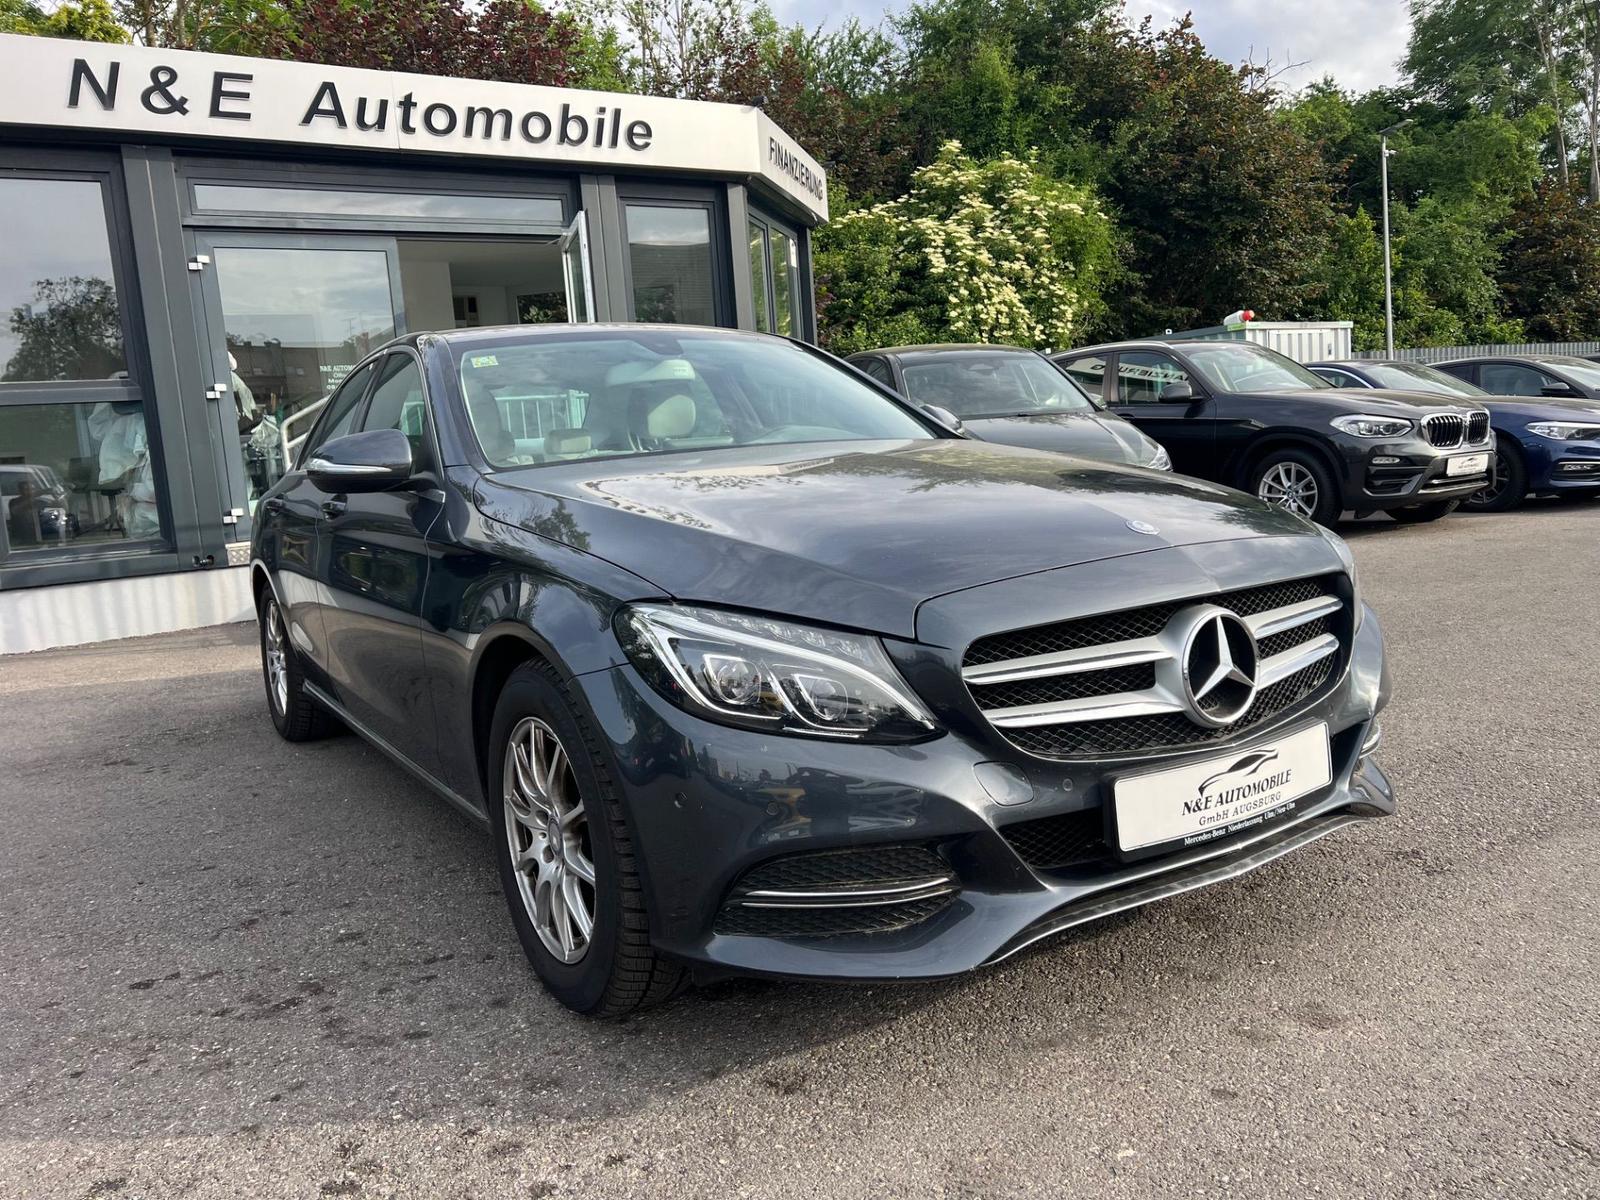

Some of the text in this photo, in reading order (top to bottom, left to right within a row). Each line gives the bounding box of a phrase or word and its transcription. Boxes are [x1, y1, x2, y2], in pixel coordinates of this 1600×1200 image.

[299, 81, 652, 151] Automobile
[769, 136, 823, 201] FINANZIERUNG
[1182, 769, 1292, 816] N&E AUTOMOBILE
[1198, 791, 1281, 826] GmbH AUGSBURG
[1184, 827, 1226, 846] Mercedes-Benz
[1227, 815, 1263, 833] Niederlassung
